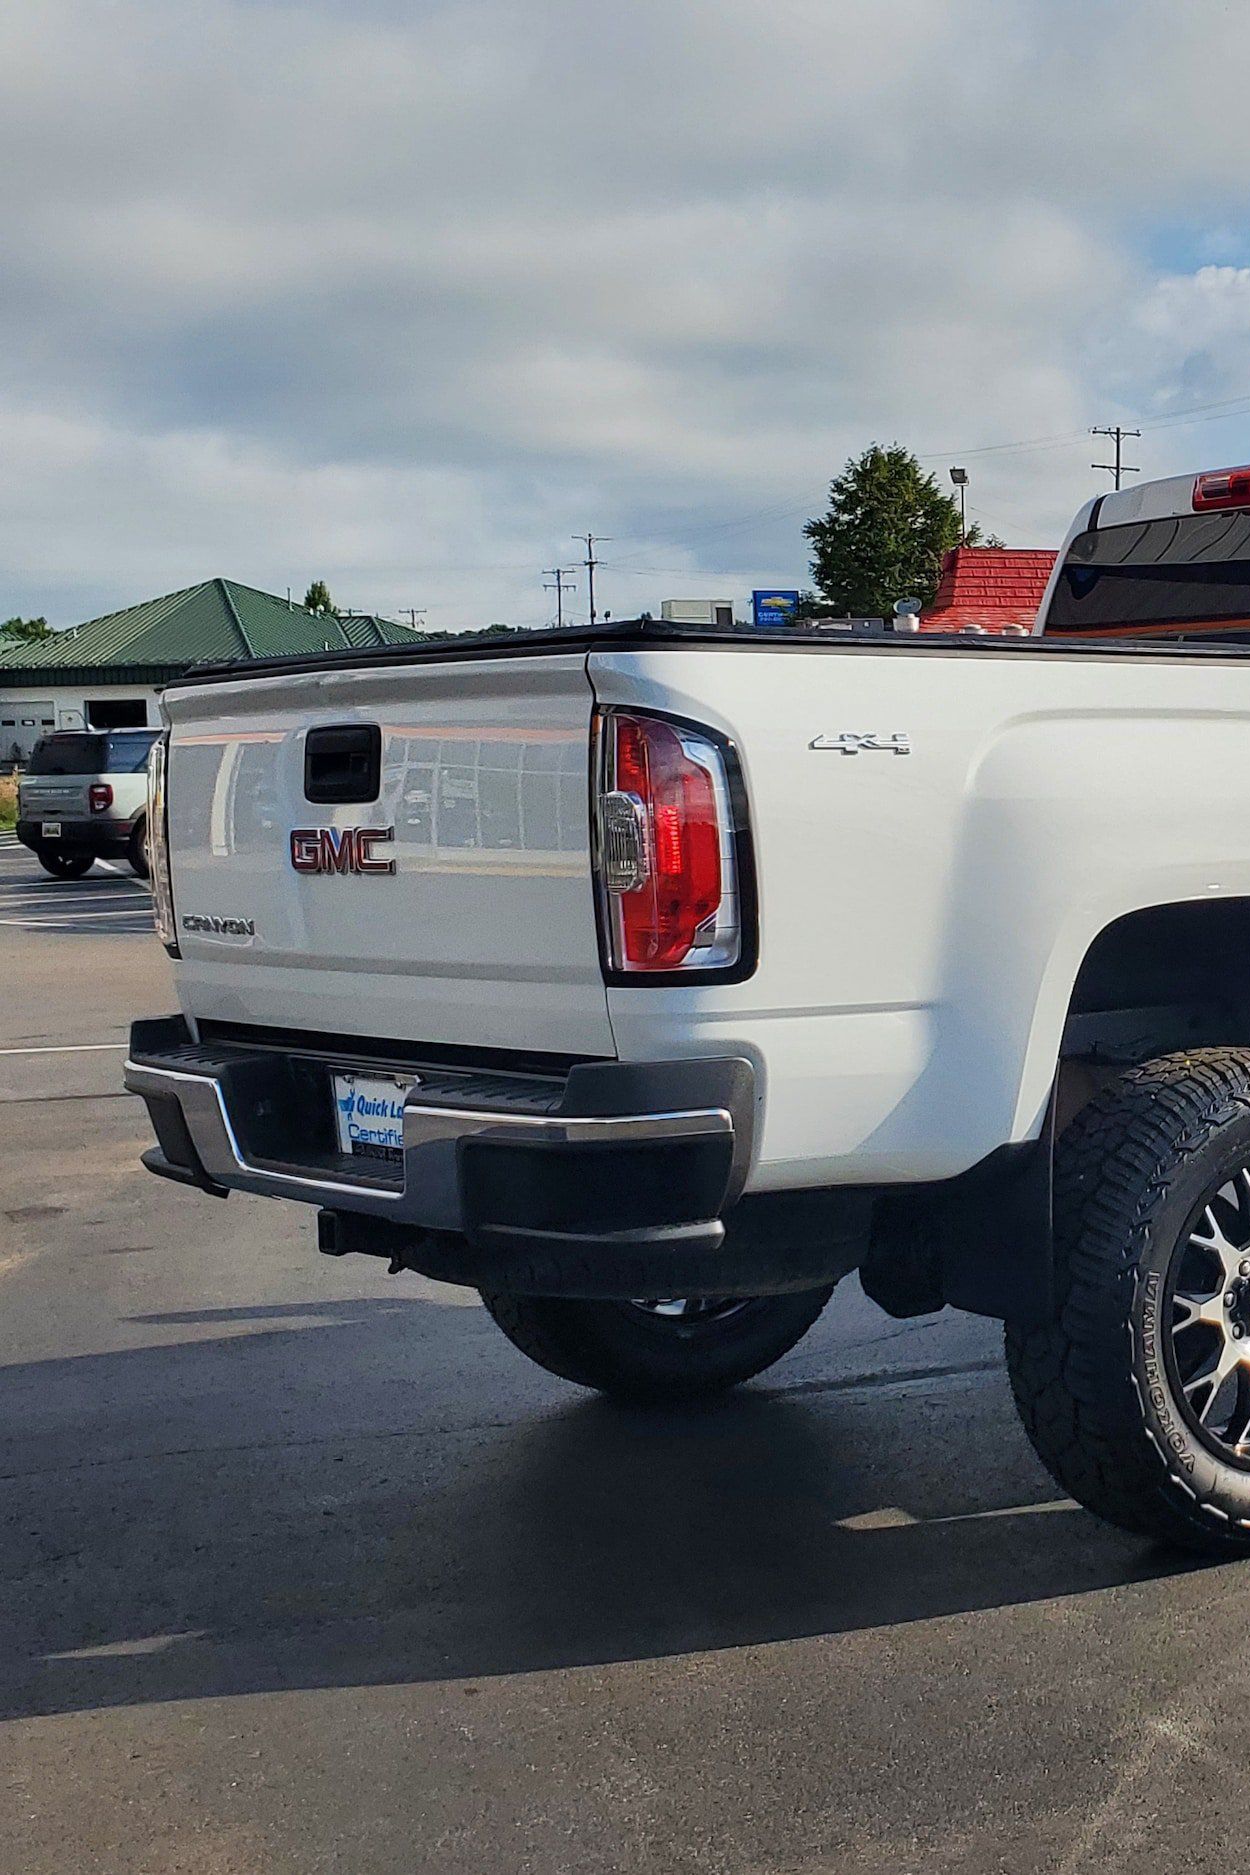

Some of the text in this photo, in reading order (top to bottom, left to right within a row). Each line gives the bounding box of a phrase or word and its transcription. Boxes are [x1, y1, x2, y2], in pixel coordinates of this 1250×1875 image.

[290, 826, 397, 875] GMC
[182, 914, 255, 935] CANYON
[357, 1094, 389, 1117] Quick
[1142, 1270, 1195, 1474] YOKOHAMA
